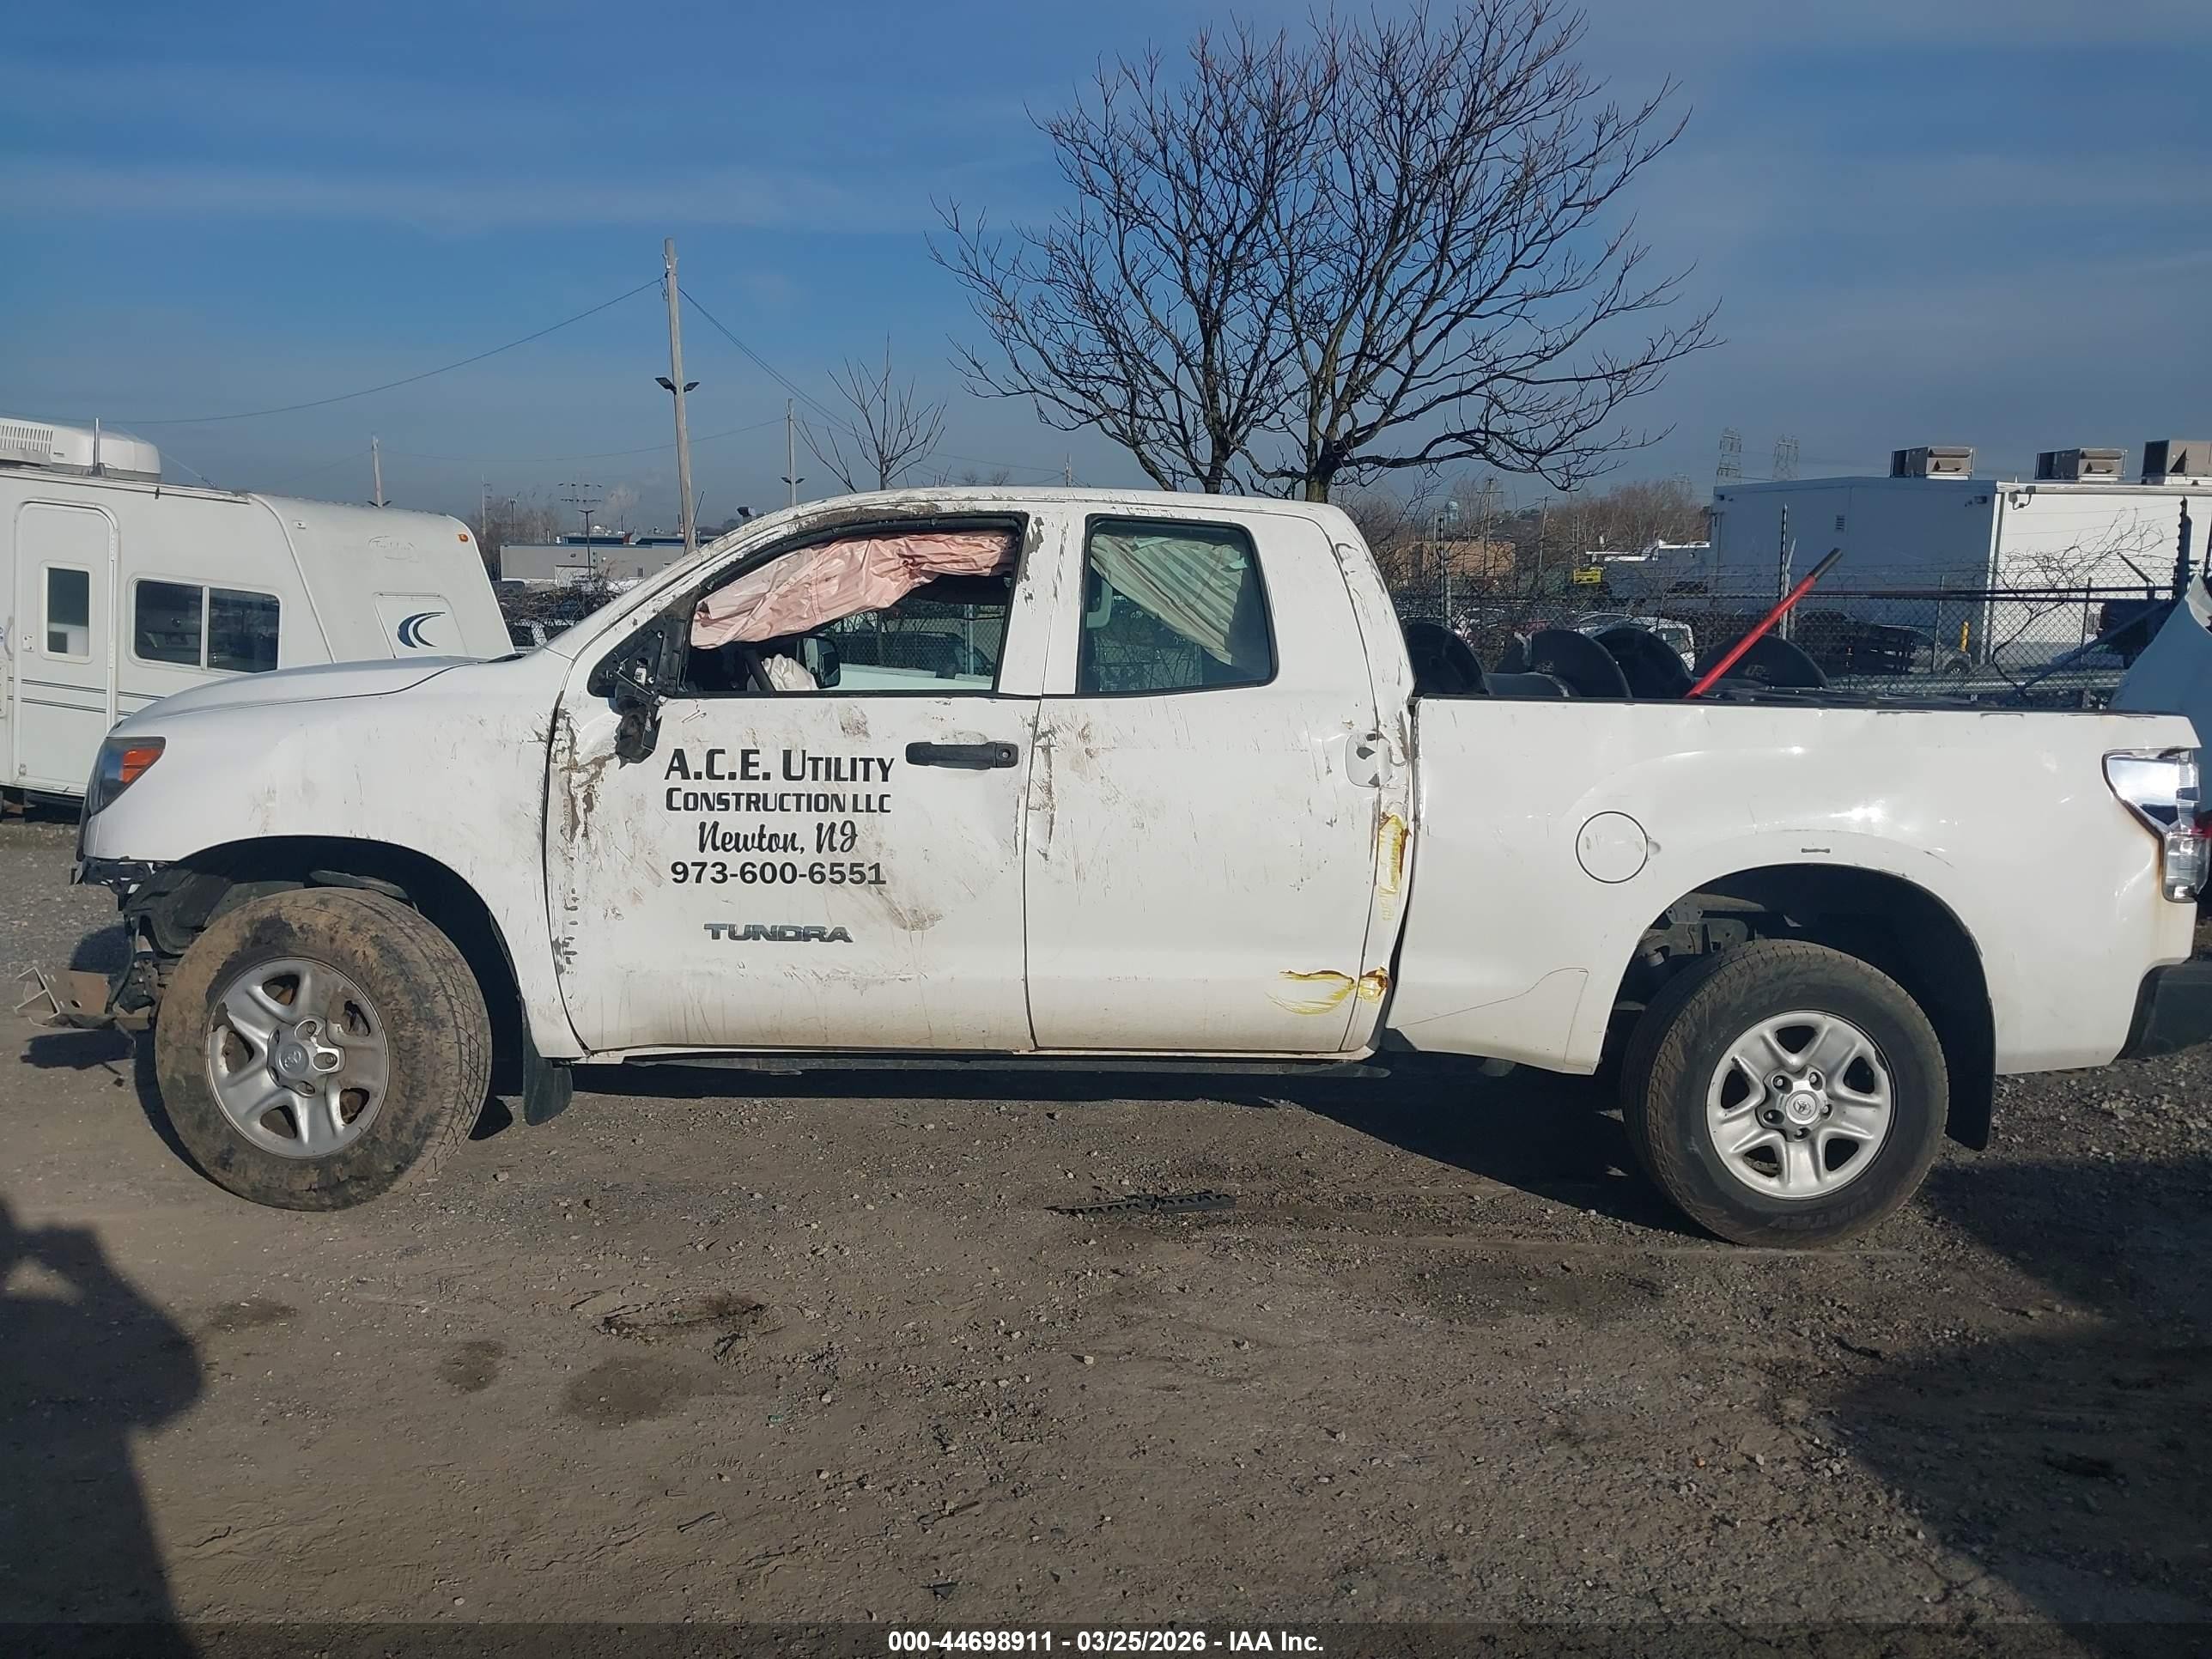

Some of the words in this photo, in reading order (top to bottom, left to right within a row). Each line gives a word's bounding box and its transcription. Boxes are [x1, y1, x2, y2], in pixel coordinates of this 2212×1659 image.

[664, 748, 771, 781] A.C.E.
[782, 749, 895, 782] UTILITY
[665, 787, 846, 813] CONSTRUCTION
[852, 793, 891, 813] LLC
[697, 820, 805, 854] Newton,
[816, 819, 859, 854] NJ
[671, 860, 887, 885] 973-600-6551
[703, 923, 854, 943] TUNDRA
